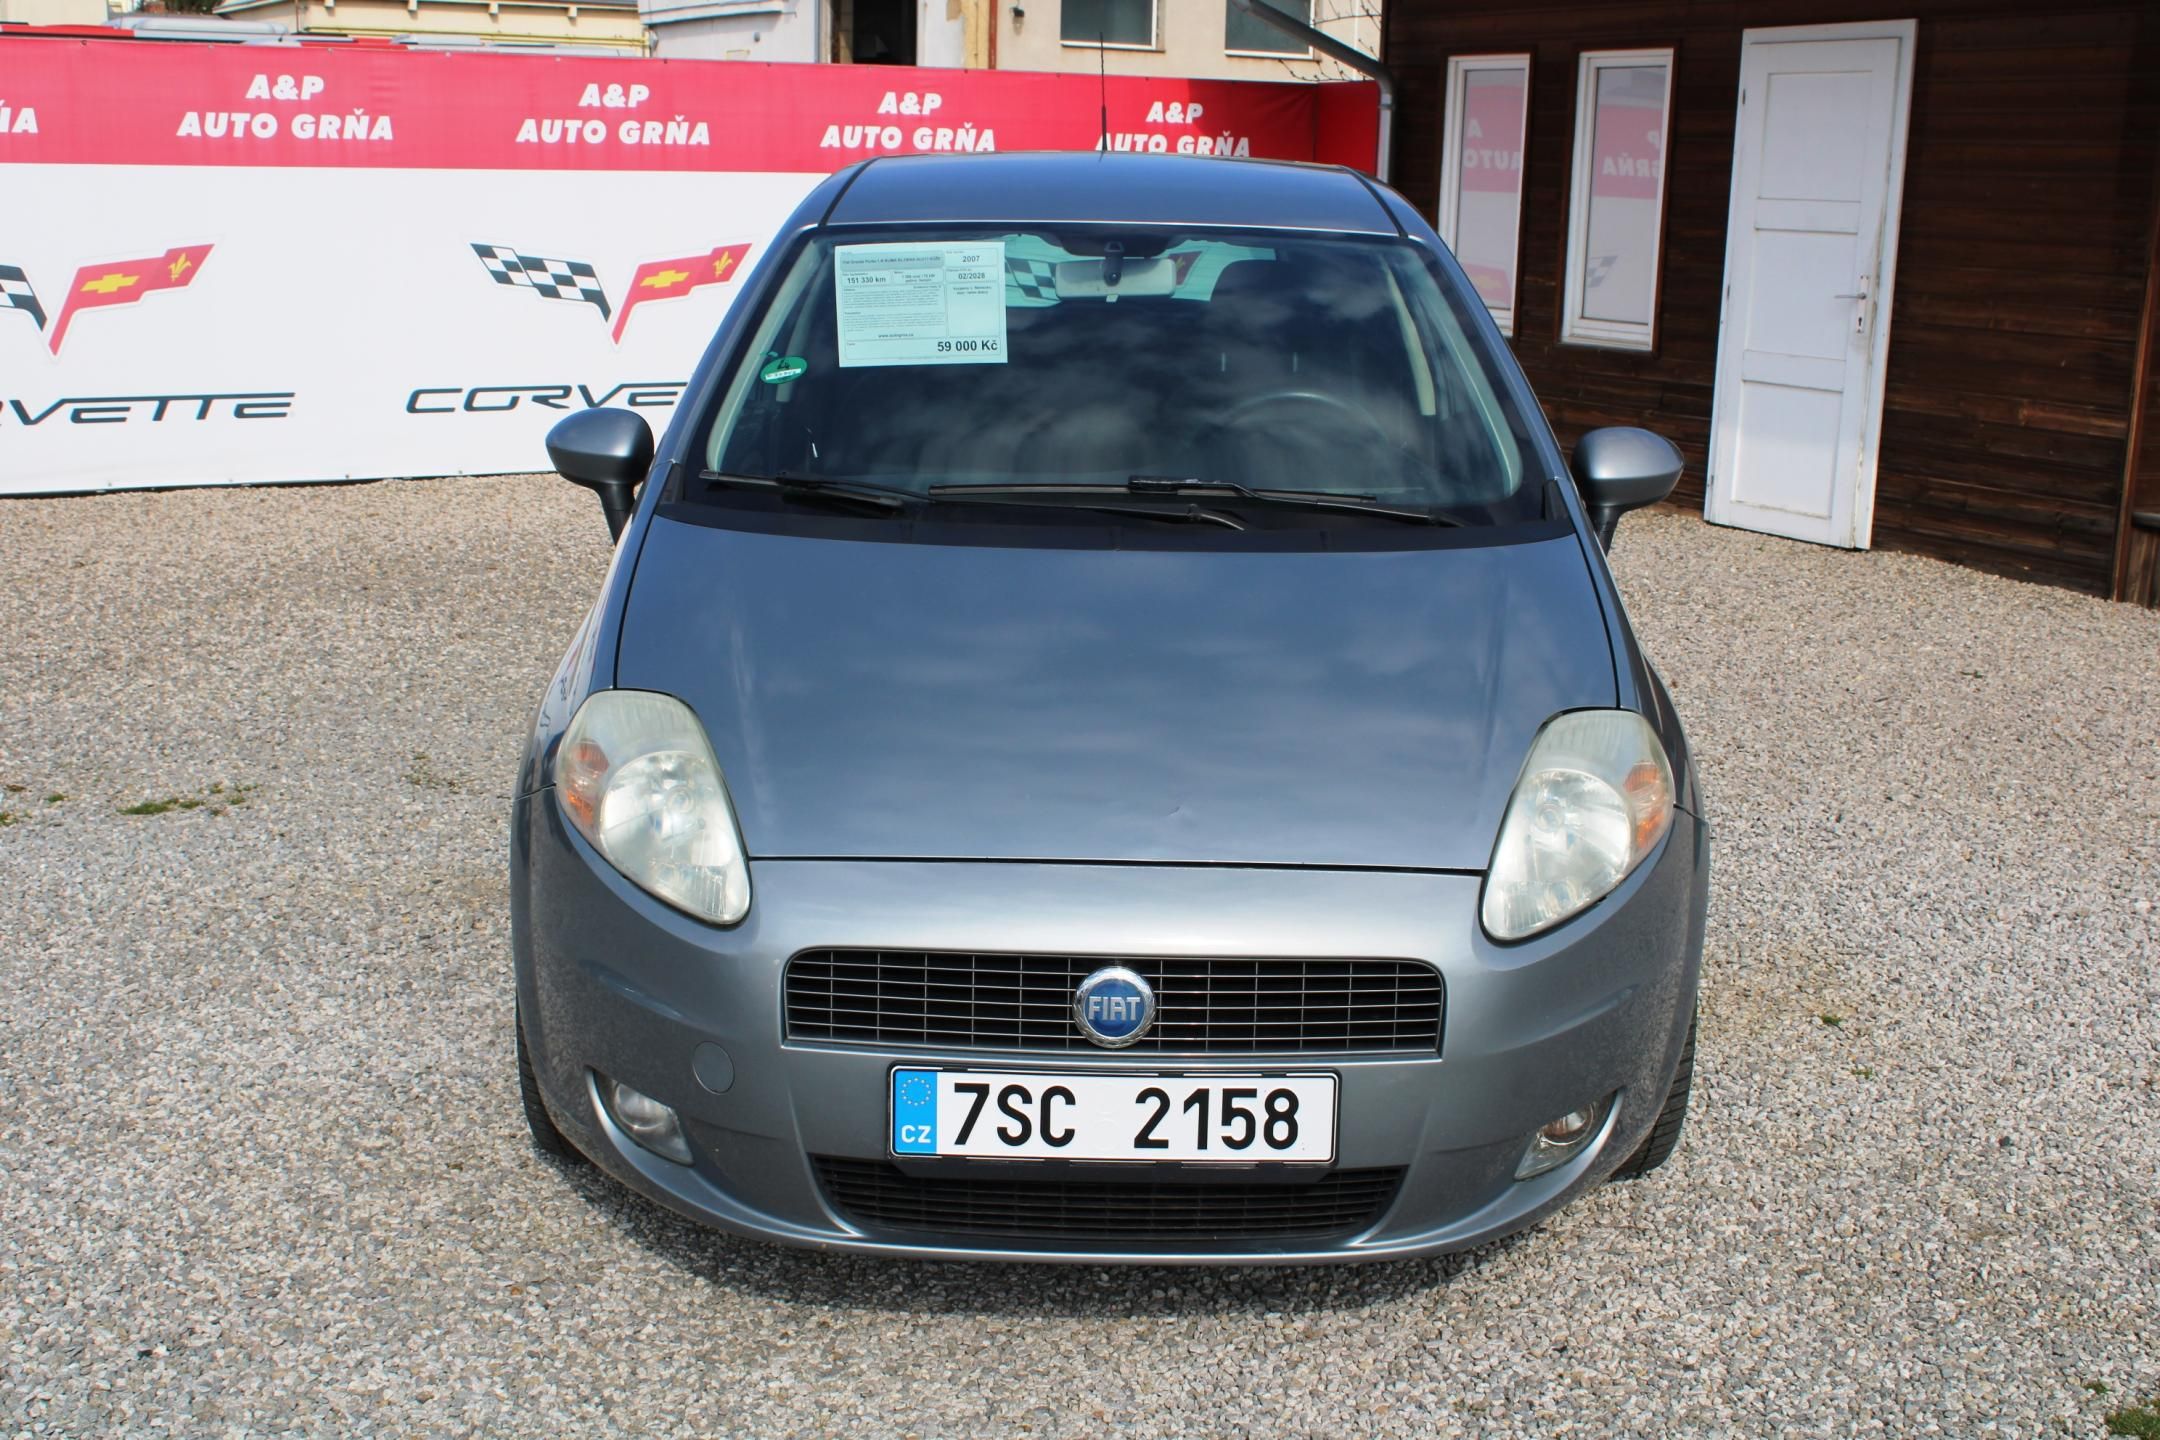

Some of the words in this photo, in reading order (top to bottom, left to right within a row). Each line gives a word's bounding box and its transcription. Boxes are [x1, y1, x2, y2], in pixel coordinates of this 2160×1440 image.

[246, 74, 325, 100] A&P
[578, 84, 650, 108] A&P
[878, 91, 942, 115] A&P
[1145, 101, 1204, 124] A&P
[176, 111, 278, 139] AUTO
[291, 108, 393, 140] GRŇA
[516, 119, 607, 145] AUTO
[618, 114, 710, 146] GRŇA
[820, 125, 903, 149] AUTO
[912, 122, 996, 152] GRŇA
[1177, 130, 1250, 157] GRŇA
[962, 255, 980, 263] 2007
[958, 272, 986, 280] 02/2028
[937, 341, 952, 351] 59
[956, 340, 977, 351] 000
[981, 339, 998, 350] Kč
[0, 392, 296, 425] VETTE
[406, 382, 688, 413] CORVE
[1087, 996, 1141, 1021] FIAT
[953, 1082, 1076, 1148] 7SC
[1134, 1087, 1299, 1151] 2158
[901, 1125, 931, 1144] CZ
